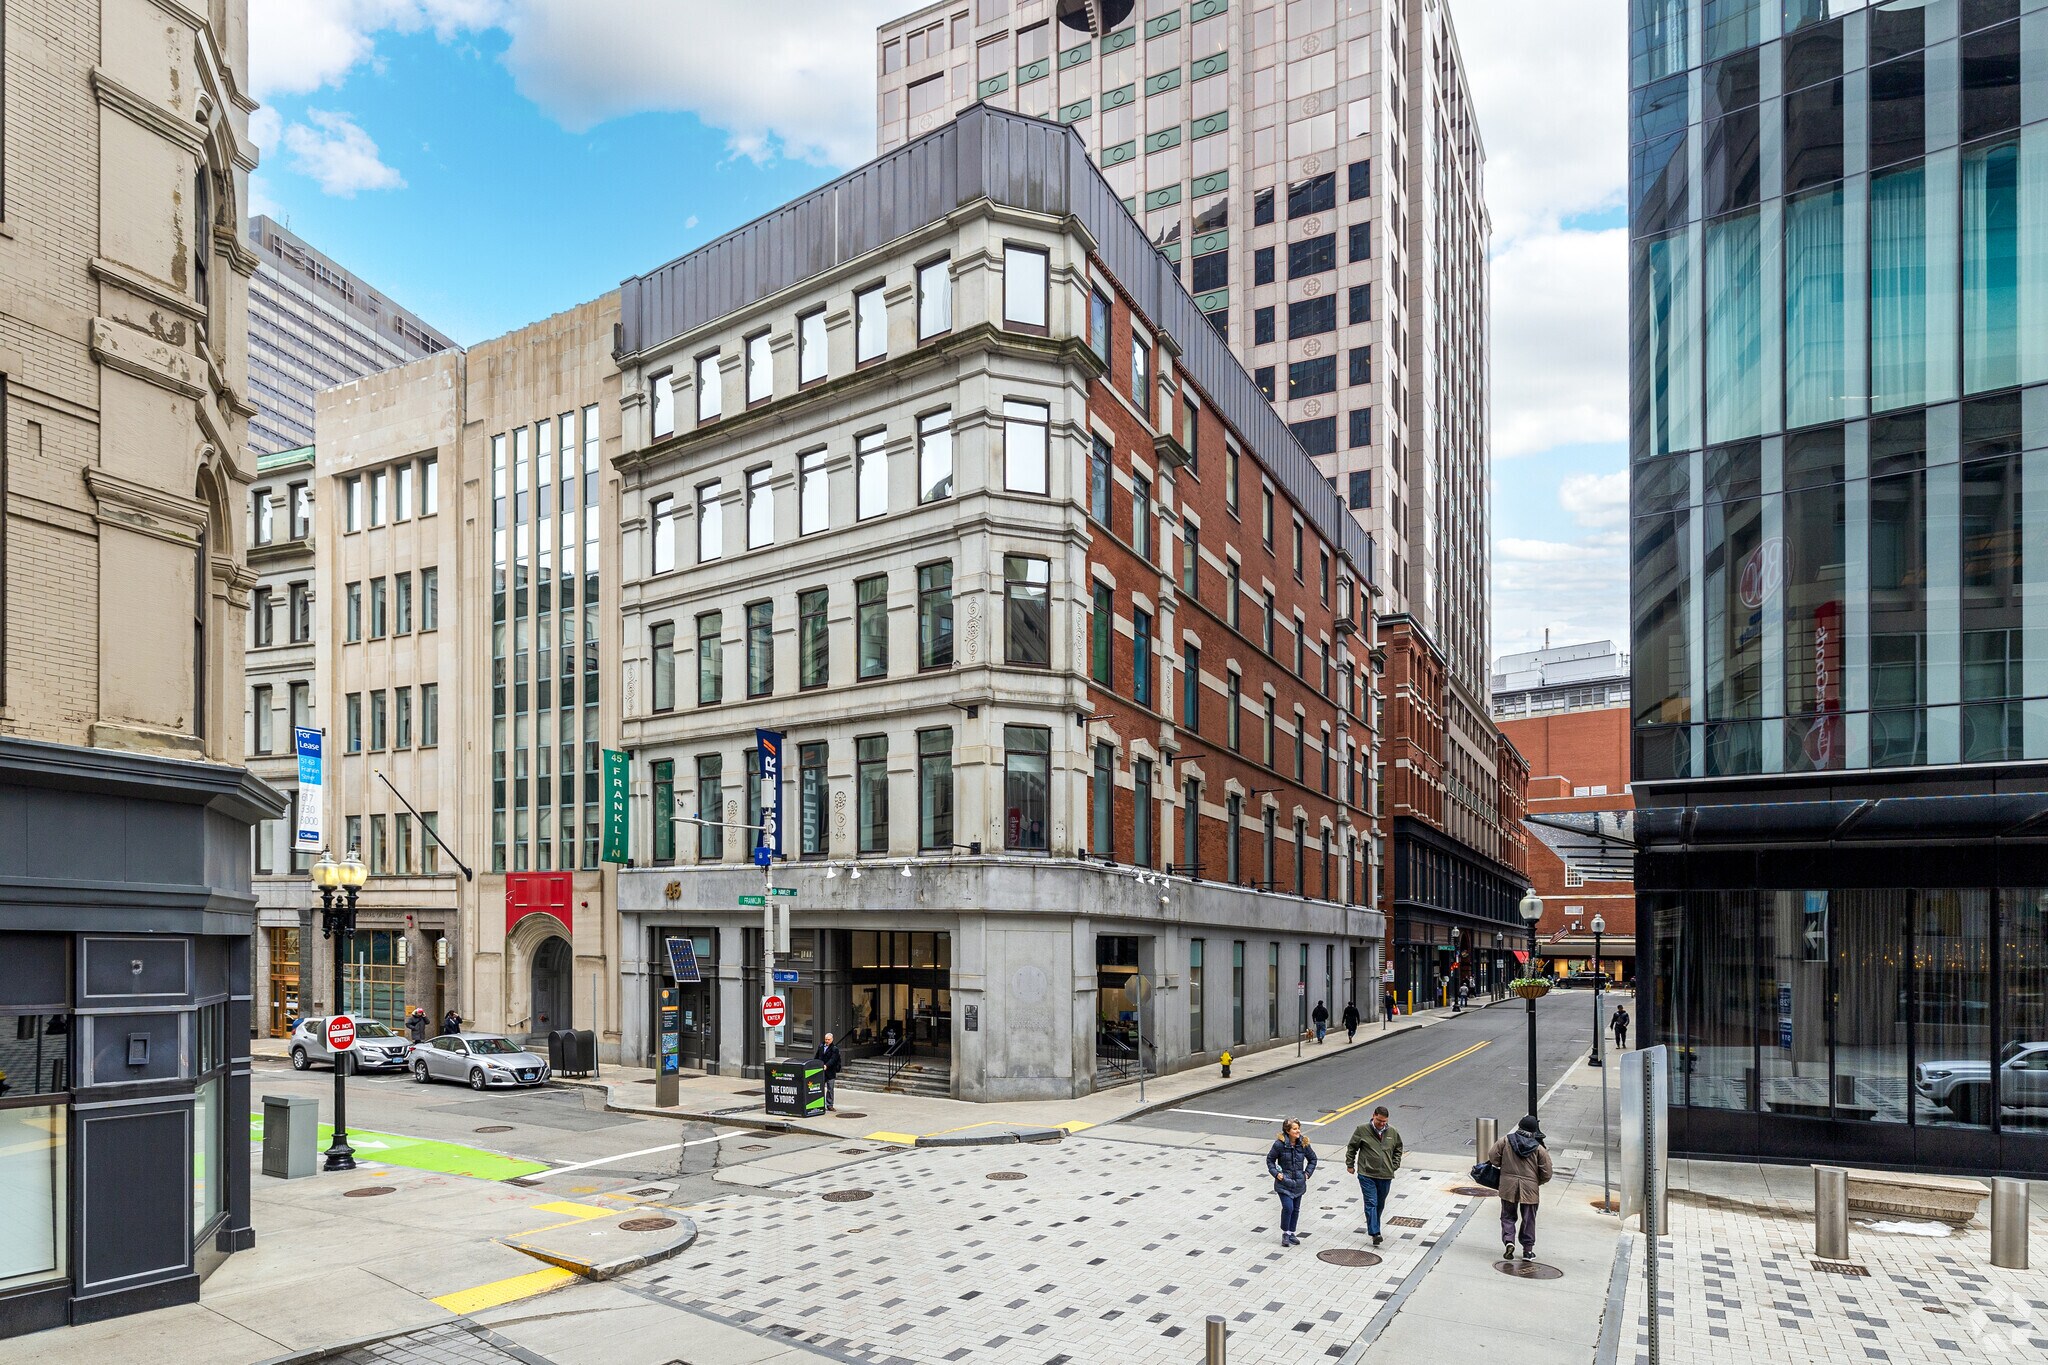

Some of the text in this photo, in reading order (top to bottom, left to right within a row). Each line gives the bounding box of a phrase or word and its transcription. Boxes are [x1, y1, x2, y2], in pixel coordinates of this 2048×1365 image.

[299, 740, 320, 751] Lease
[611, 754, 622, 763] 45
[612, 767, 623, 858] FRANKLIN
[665, 880, 681, 900] 45
[771, 1085, 780, 1094] THE
[780, 1085, 798, 1095] CROWN
[774, 1095, 795, 1104] IS YOURS
